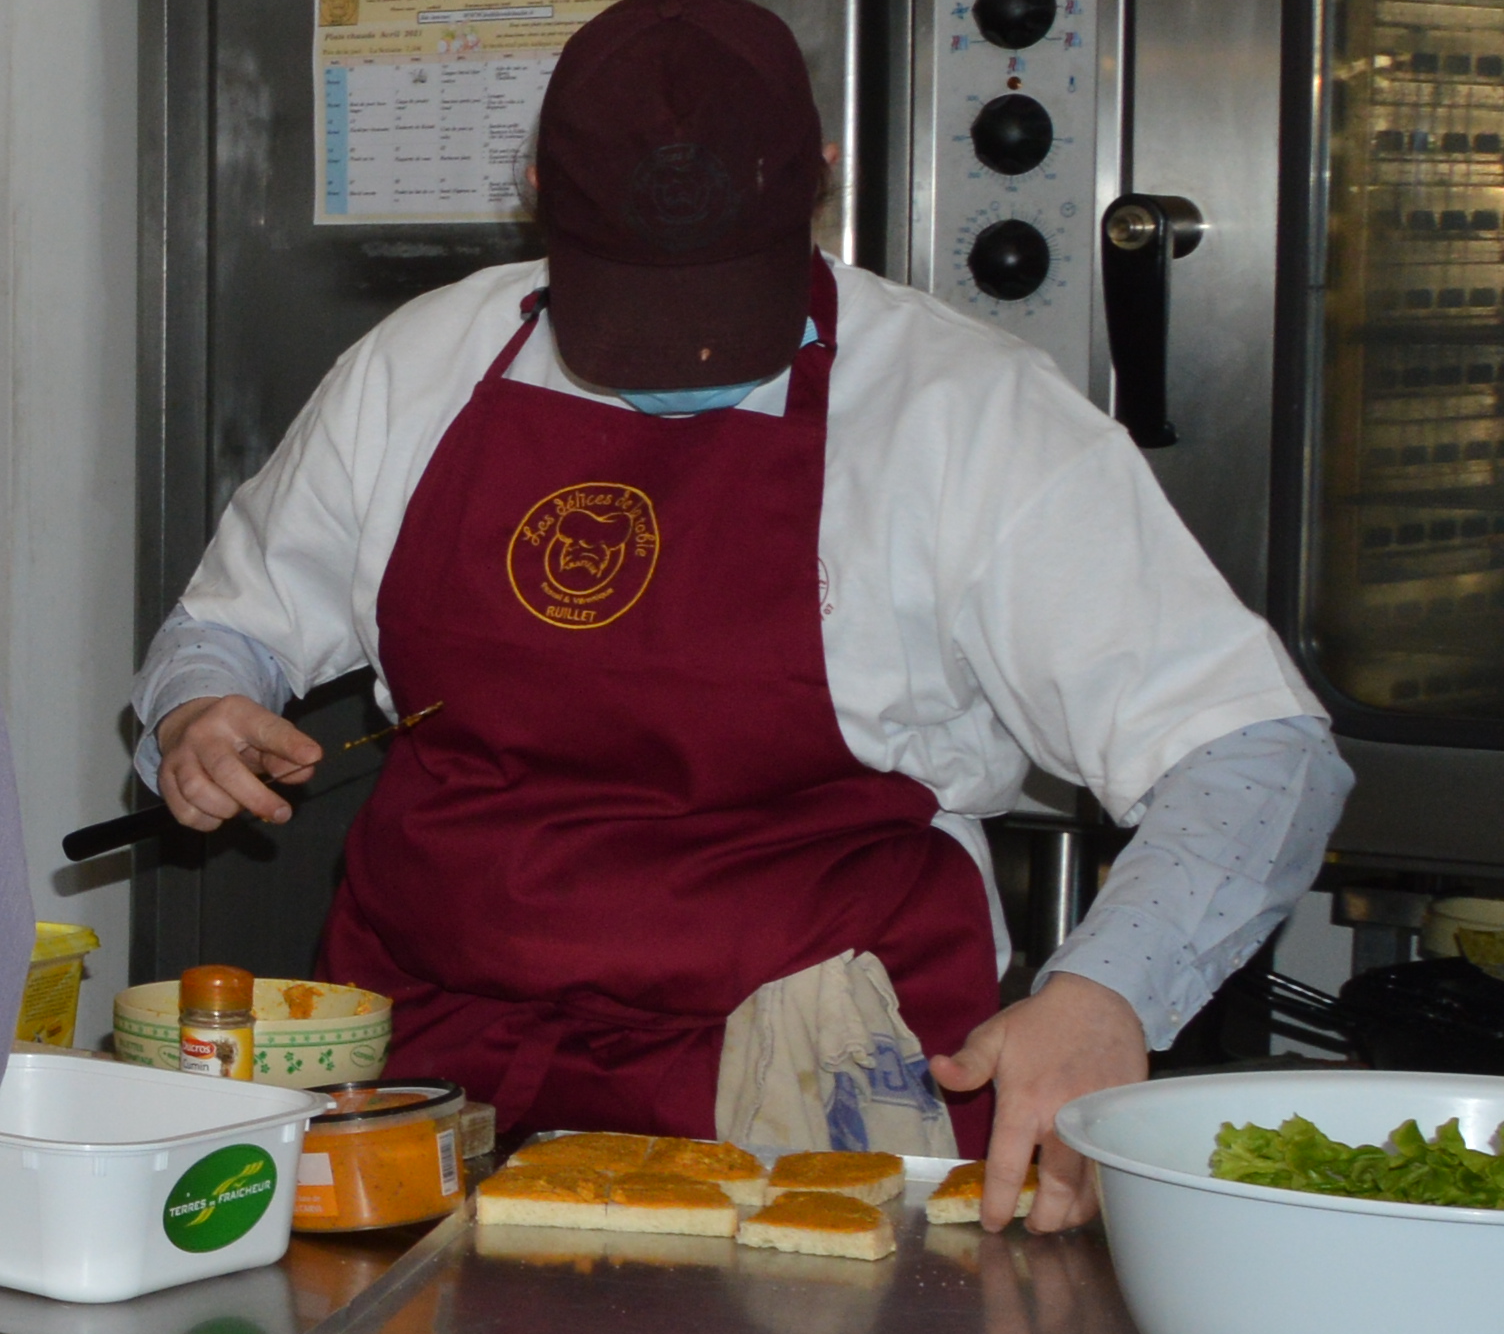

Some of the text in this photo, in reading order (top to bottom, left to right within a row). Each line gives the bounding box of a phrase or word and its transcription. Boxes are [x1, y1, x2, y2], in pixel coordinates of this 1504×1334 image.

[553, 490, 613, 516] délices
[546, 605, 597, 622] RUILLET
[169, 1198, 207, 1217] TERRES
